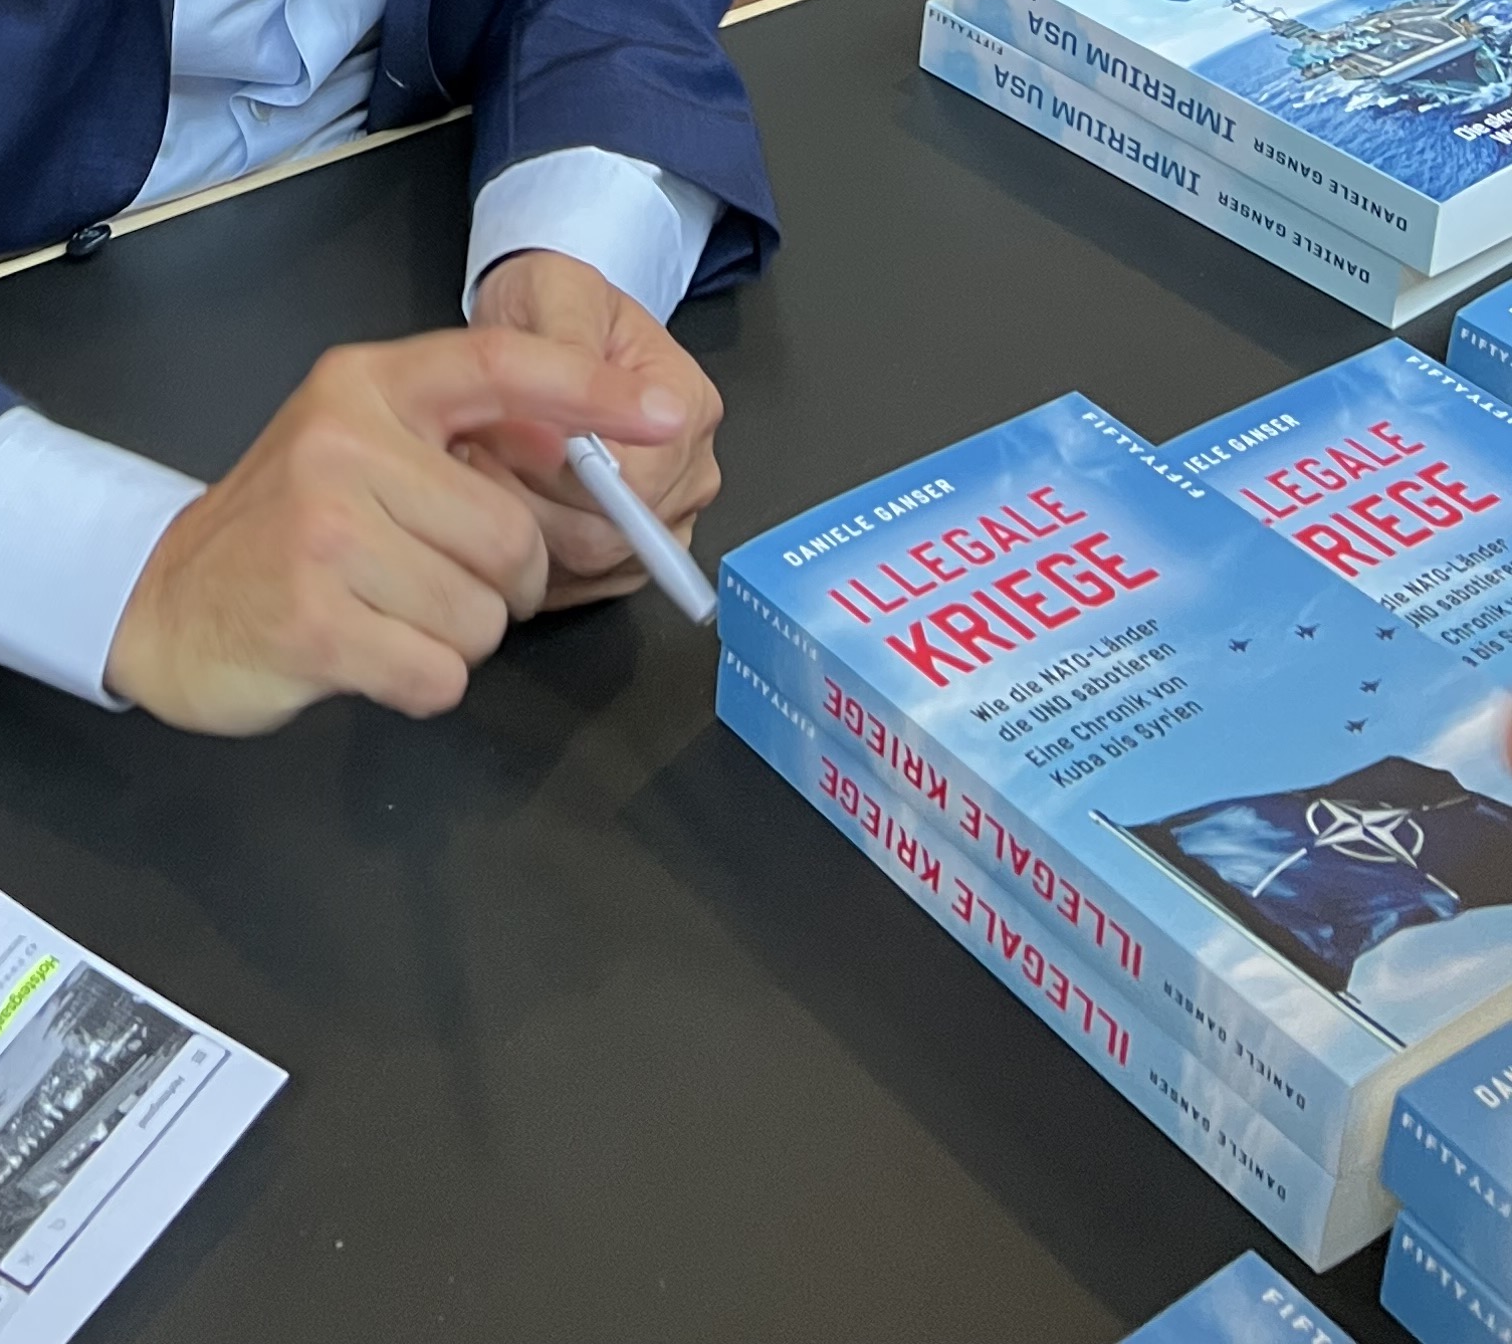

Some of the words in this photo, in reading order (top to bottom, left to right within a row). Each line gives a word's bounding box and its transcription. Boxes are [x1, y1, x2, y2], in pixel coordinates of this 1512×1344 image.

[1028, 9, 1077, 56] USA
[994, 63, 1043, 110] USA
[1087, 42, 1236, 143] IMPERIUM
[1051, 100, 1200, 196] IMPERIUM
[1253, 137, 1323, 186] GANSER
[1217, 190, 1287, 238] GANSER
[1329, 179, 1408, 232] DANIELE
[1292, 230, 1370, 284] DANIELE
[1183, 446, 1232, 474] IELE
[1228, 414, 1301, 452] GANSER
[1239, 420, 1426, 522] LEGALE
[783, 515, 875, 567] DANIELE
[873, 478, 956, 522] GANSER
[827, 485, 1088, 624] ILLEGALE
[1293, 461, 1502, 578] RIEGE
[884, 532, 1160, 688] KRIEGE
[1403, 538, 1509, 597] NATO-Länder
[1437, 561, 1512, 611] sabotiere
[969, 699, 1010, 723] Wie
[1009, 680, 1043, 703] die
[1038, 618, 1160, 685] NATO-Länder
[1441, 605, 1511, 646] Chronik
[998, 719, 1033, 743] die
[1029, 695, 1072, 723] UNO
[1071, 641, 1177, 702] sabotieren
[1024, 737, 1074, 768] Eine
[1070, 693, 1151, 742] Chronik
[1147, 676, 1189, 700] von
[824, 676, 949, 811] KRIEGE
[1049, 753, 1106, 789] Kuba
[1101, 734, 1138, 758] bis
[1134, 699, 1204, 740] Syrien
[819, 755, 941, 894] KRIEGE
[959, 793, 1143, 981] ILLEGALE
[951, 877, 1130, 1067] ILLEGALE
[1236, 1041, 1306, 1111] DANIELE
[1219, 1130, 1286, 1203] DANIELE
